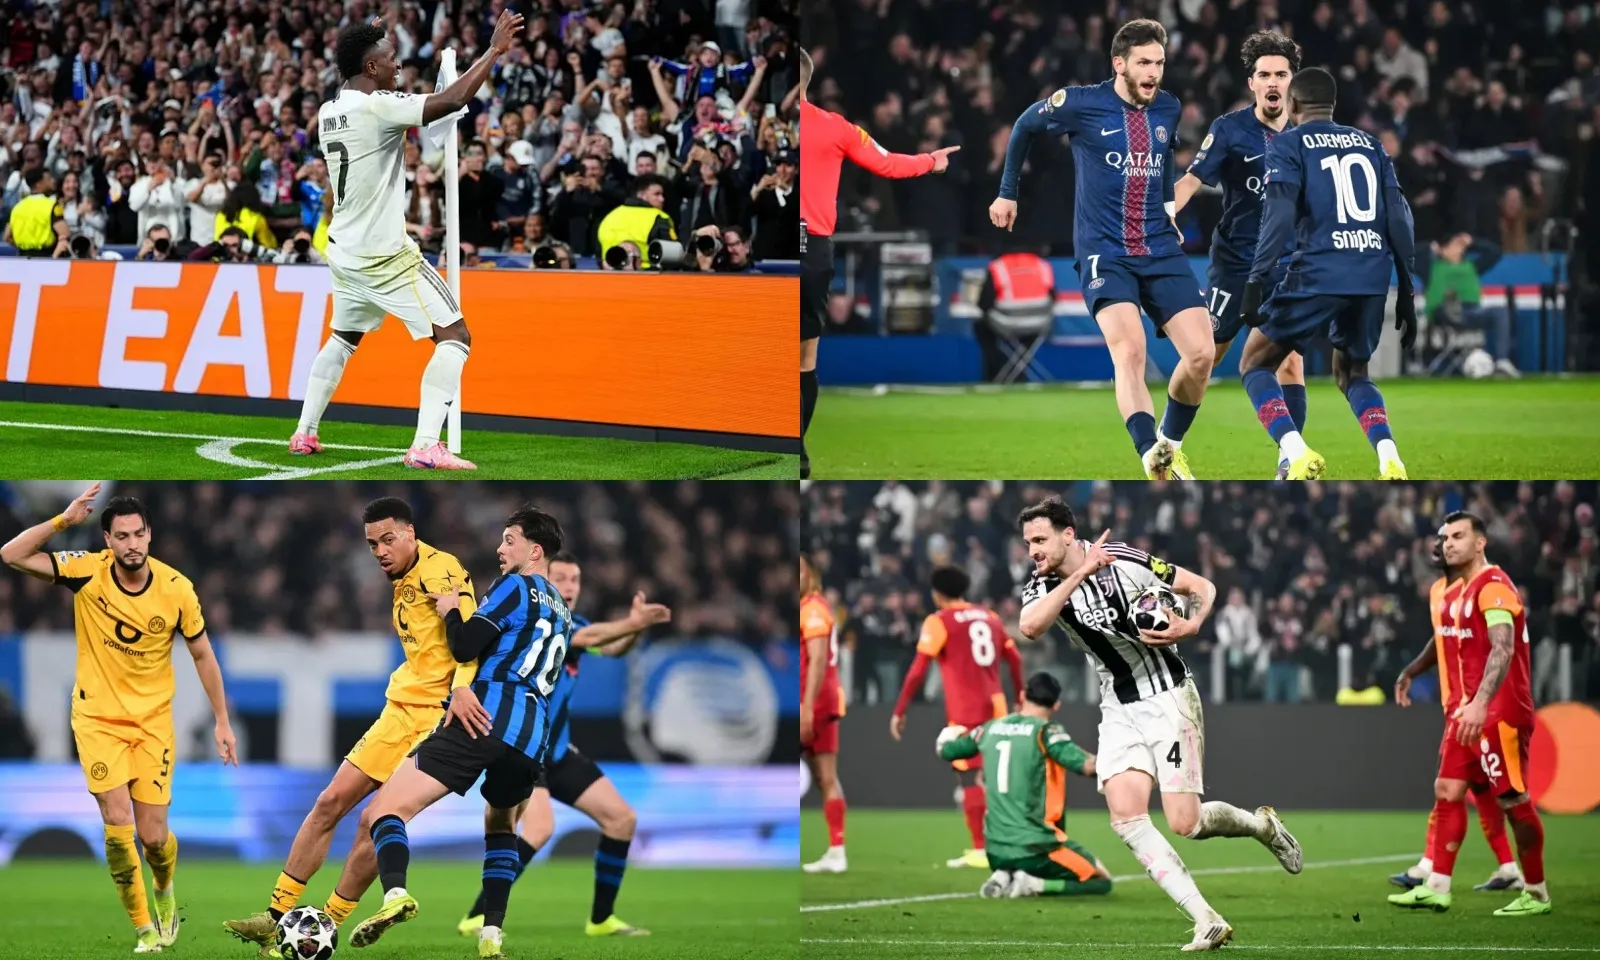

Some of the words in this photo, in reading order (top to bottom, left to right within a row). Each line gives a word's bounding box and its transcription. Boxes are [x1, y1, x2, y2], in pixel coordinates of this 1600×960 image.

[337, 114, 350, 130] JR.
[327, 141, 349, 206] 7
[1105, 151, 1162, 169] QATAR
[1121, 167, 1161, 177] AIRWAYS
[1320, 152, 1378, 224] 10
[1331, 228, 1382, 252] snipes
[1087, 254, 1101, 279] 7
[1209, 287, 1232, 317] 17
[98, 263, 333, 400] EAT
[530, 588, 574, 628] SAMARD
[103, 638, 146, 657] vodafone
[516, 617, 567, 697] 10
[968, 620, 996, 667] 8
[160, 748, 169, 777] 5
[995, 740, 1013, 794] 1
[1166, 741, 1182, 769] 4
[1480, 753, 1502, 778] 42
